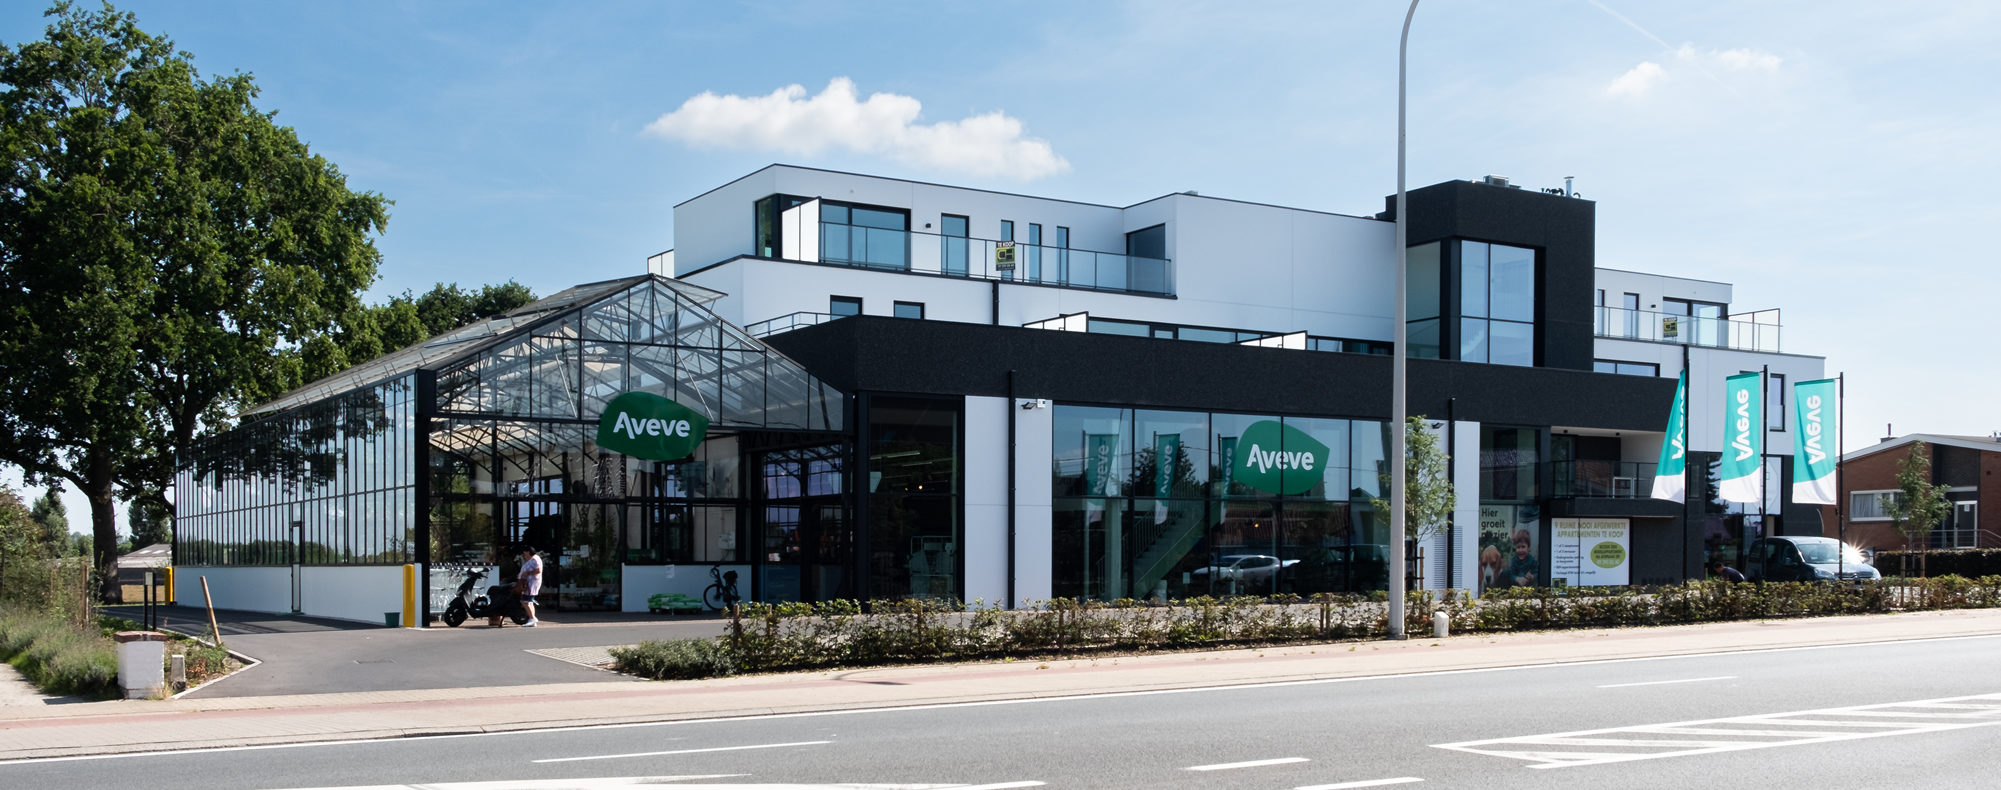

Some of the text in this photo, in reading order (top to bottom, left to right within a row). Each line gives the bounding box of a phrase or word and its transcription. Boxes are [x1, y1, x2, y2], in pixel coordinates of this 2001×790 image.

[612, 411, 691, 440] Aveve
[1246, 443, 1315, 474] Aveve
[1481, 508, 1498, 518] Hier
[1481, 518, 1505, 531] groeit
[1593, 522, 1627, 530] AFGEWERKTE
[1481, 530, 1510, 540] pzier.
[1557, 530, 1601, 538] APPARTEMENTEN
